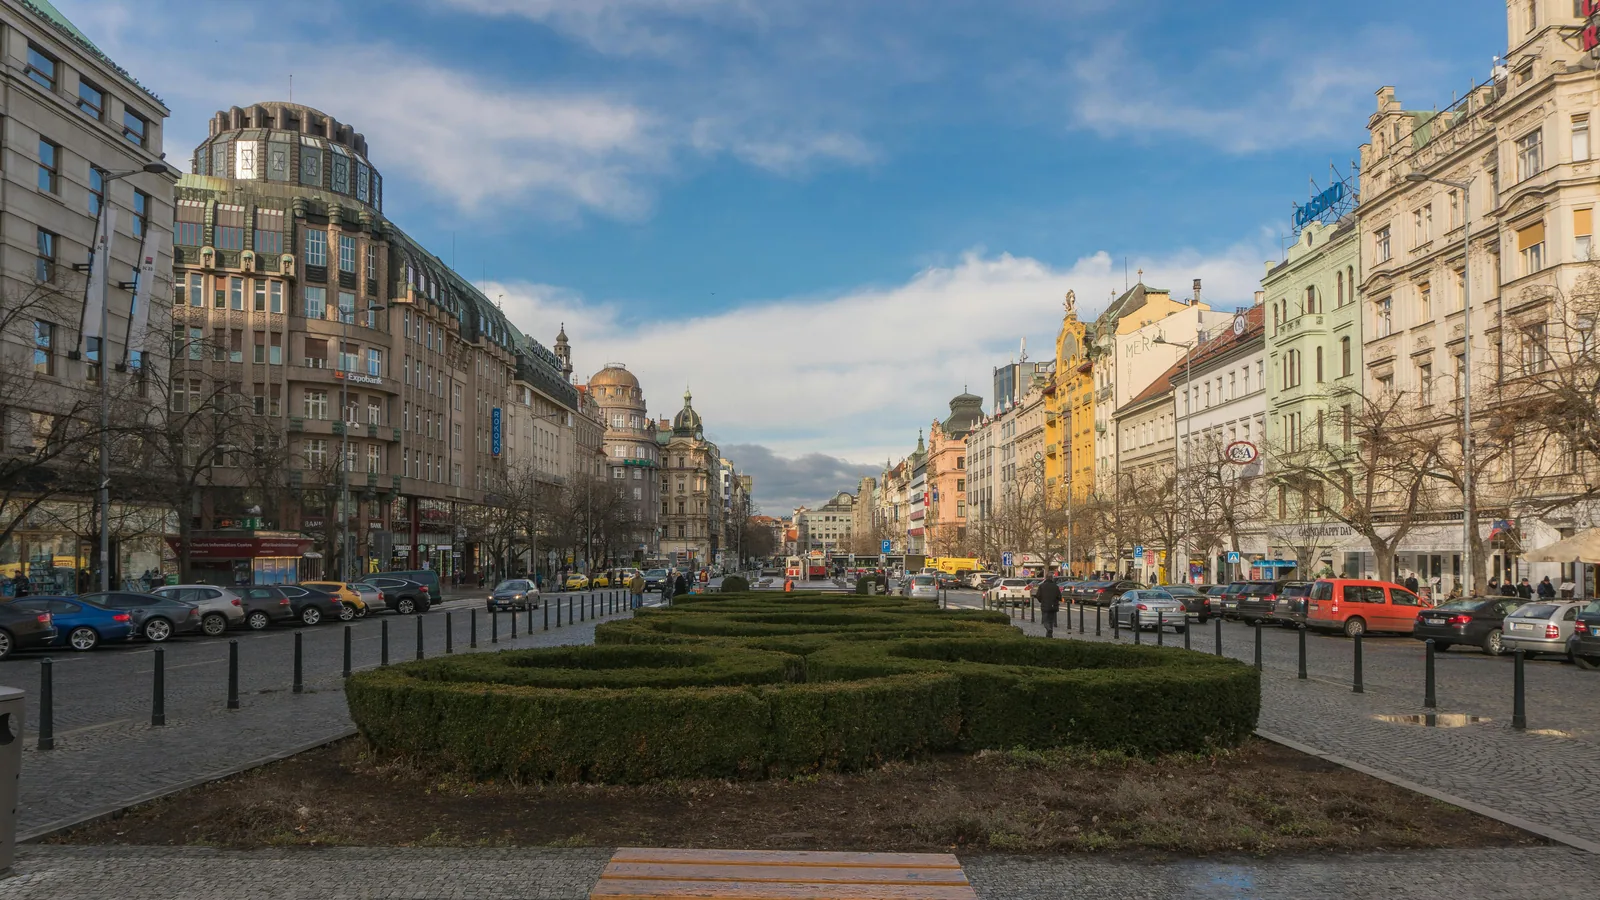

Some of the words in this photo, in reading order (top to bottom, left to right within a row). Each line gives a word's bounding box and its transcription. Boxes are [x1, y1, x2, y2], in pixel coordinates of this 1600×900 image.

[1296, 181, 1344, 226] CASINO
[1126, 330, 1167, 358] MERAN
[348, 372, 382, 384] Expobank
[1232, 447, 1252, 459] C&A
[304, 520, 323, 528] BANK
[1320, 526, 1339, 536] HAPPY
[1340, 526, 1352, 536] DAY
